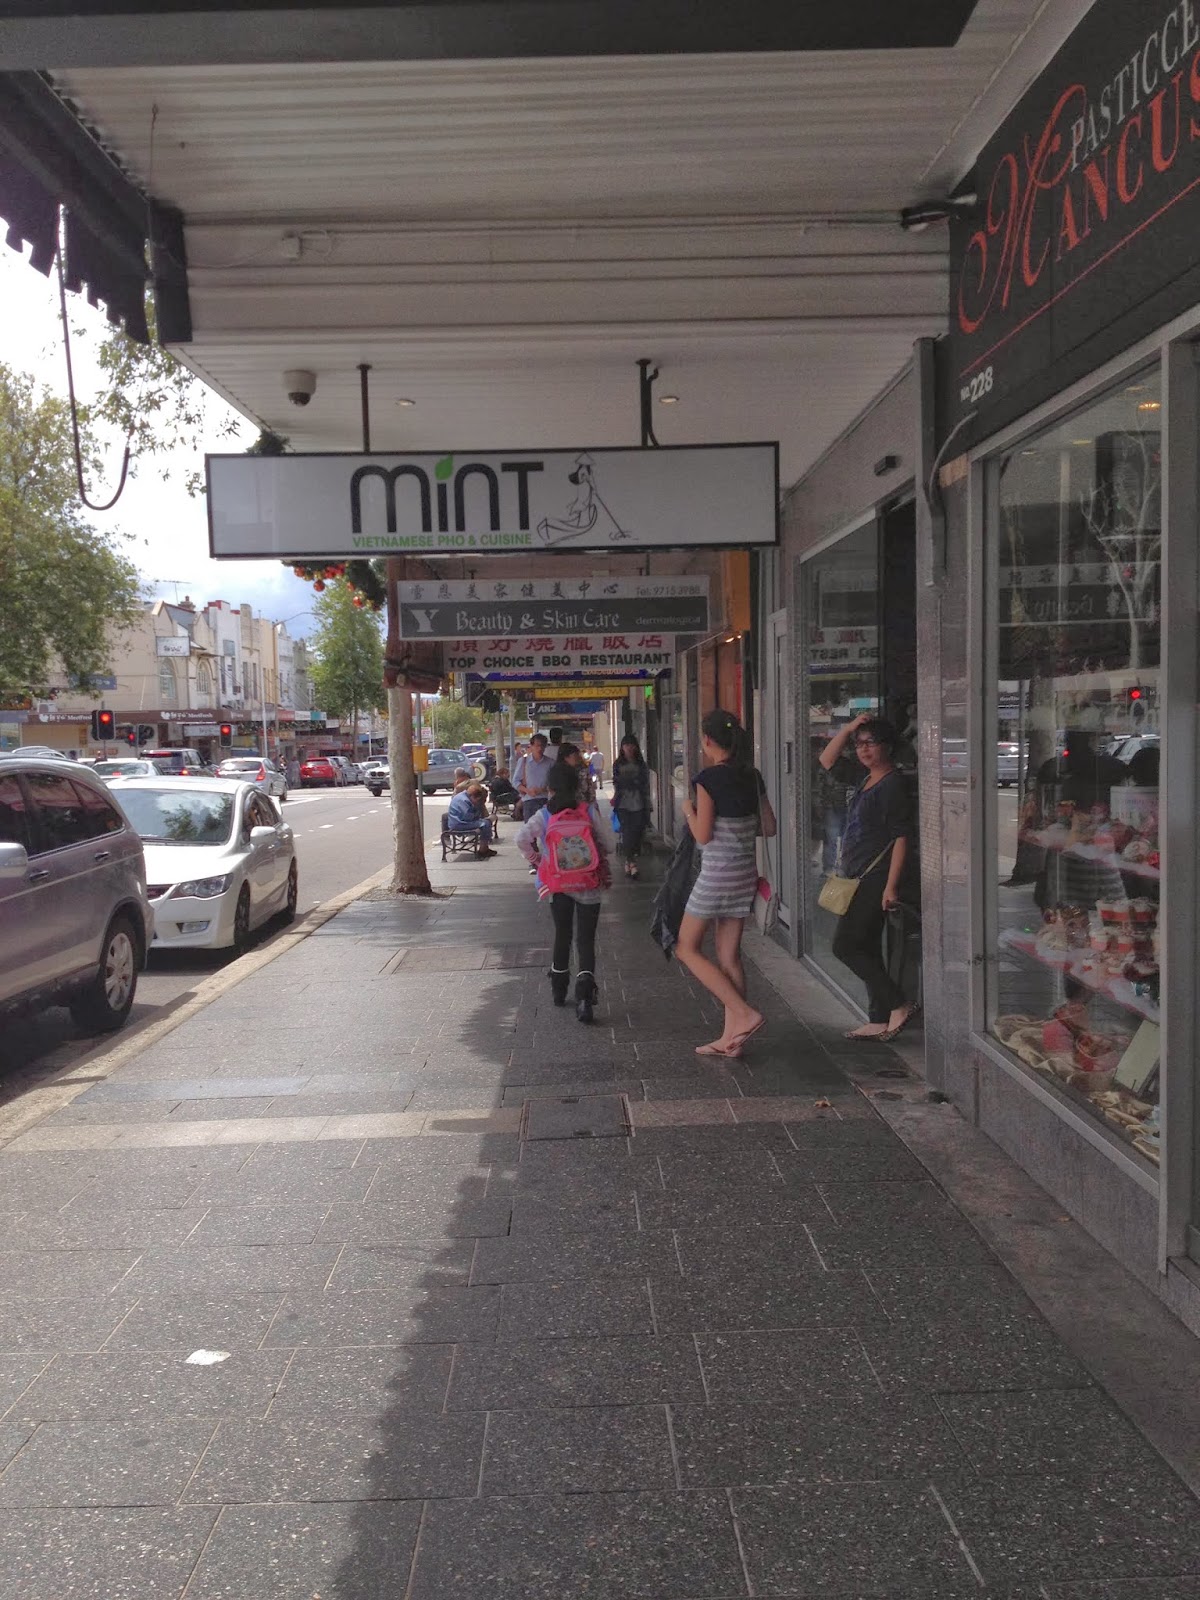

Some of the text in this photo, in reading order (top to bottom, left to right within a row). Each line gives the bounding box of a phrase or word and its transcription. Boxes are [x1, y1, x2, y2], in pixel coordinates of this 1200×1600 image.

[352, 533, 532, 548] VIETNAMESE PHO & CUISINE
[410, 609, 440, 633] Y
[456, 608, 620, 635] Beauty & Skin Care
[448, 653, 671, 669] TOP CHOICE BBQ RESTAURANT
[538, 705, 557, 713] ANZ
